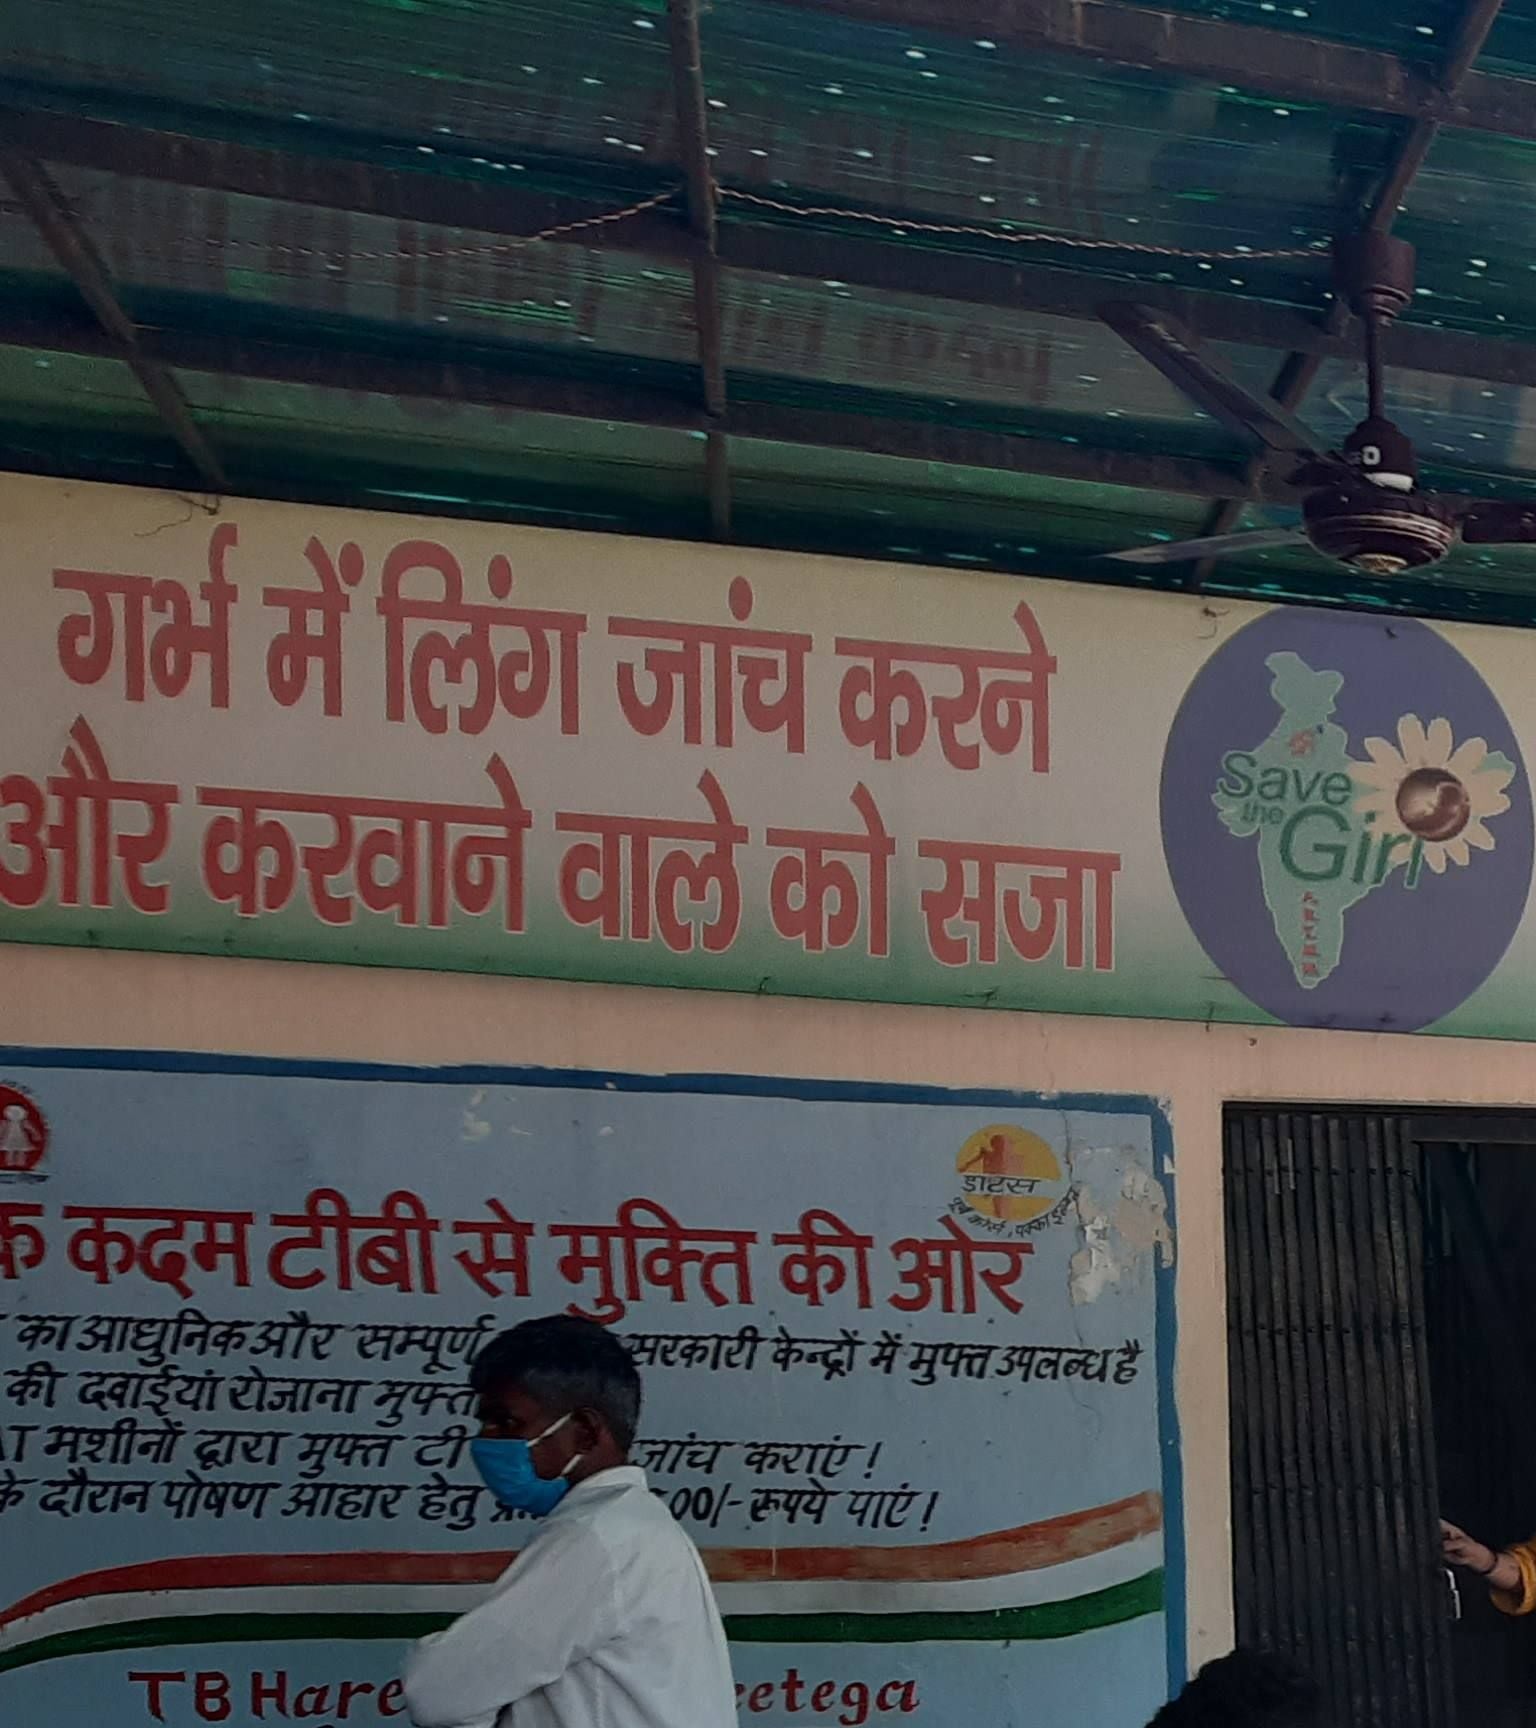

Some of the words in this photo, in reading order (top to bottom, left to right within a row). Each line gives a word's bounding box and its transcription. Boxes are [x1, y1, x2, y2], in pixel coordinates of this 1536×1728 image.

[53, 523, 237, 712] गर्भ
[264, 536, 362, 717] में
[378, 540, 587, 736] लिंग
[609, 576, 812, 754] जांच
[836, 601, 1057, 774] करने
[1218, 752, 1352, 805] Save
[0, 714, 178, 914] और
[197, 753, 531, 932] करवाने
[556, 769, 748, 955] वाले
[767, 781, 895, 958] को
[920, 839, 1120, 970] सजा
[1240, 802, 1283, 825] the
[1279, 805, 1424, 888] Girl
[62, 1205, 254, 1299] कदम
[267, 1188, 440, 1295] टीबी
[453, 1198, 534, 1299] से
[548, 1197, 757, 1325] मुक्ति
[772, 1209, 874, 1310] की
[887, 1215, 1035, 1315] ओर
[15, 1314, 82, 1351] का
[76, 1308, 255, 1367] आधुनिक
[250, 1311, 344, 1361] और
[351, 1314, 497, 1375] सम्पूर्ण
[624, 1326, 765, 1372] सरकारी
[770, 1326, 868, 1380] केन्द्रों
[869, 1331, 908, 1376] में
[908, 1342, 1000, 1386] मुफ्त
[996, 1345, 1112, 1384] उपलब्ध
[1108, 1339, 1144, 1387] है
[3, 1361, 68, 1408] की
[77, 1364, 226, 1416] दवाईयां
[229, 1366, 373, 1414] रोजाना
[374, 1380, 479, 1428] मुफ्त
[0, 1425, 40, 1463] T
[44, 1417, 187, 1464] मशीनों
[194, 1429, 294, 1470] द्वारा
[298, 1433, 407, 1479] मुफ्त
[413, 1425, 472, 1468] टी
[633, 1432, 736, 1474] जांच
[39, 1467, 156, 1518] दौरान
[159, 1469, 282, 1519] पोषण
[282, 1483, 411, 1520] आहार
[417, 1472, 487, 1530] हेतु
[650, 1483, 744, 1528] 00/-
[128, 1670, 232, 1724] TB
[251, 1670, 406, 1720] Hare
[734, 1668, 920, 1727] etega
